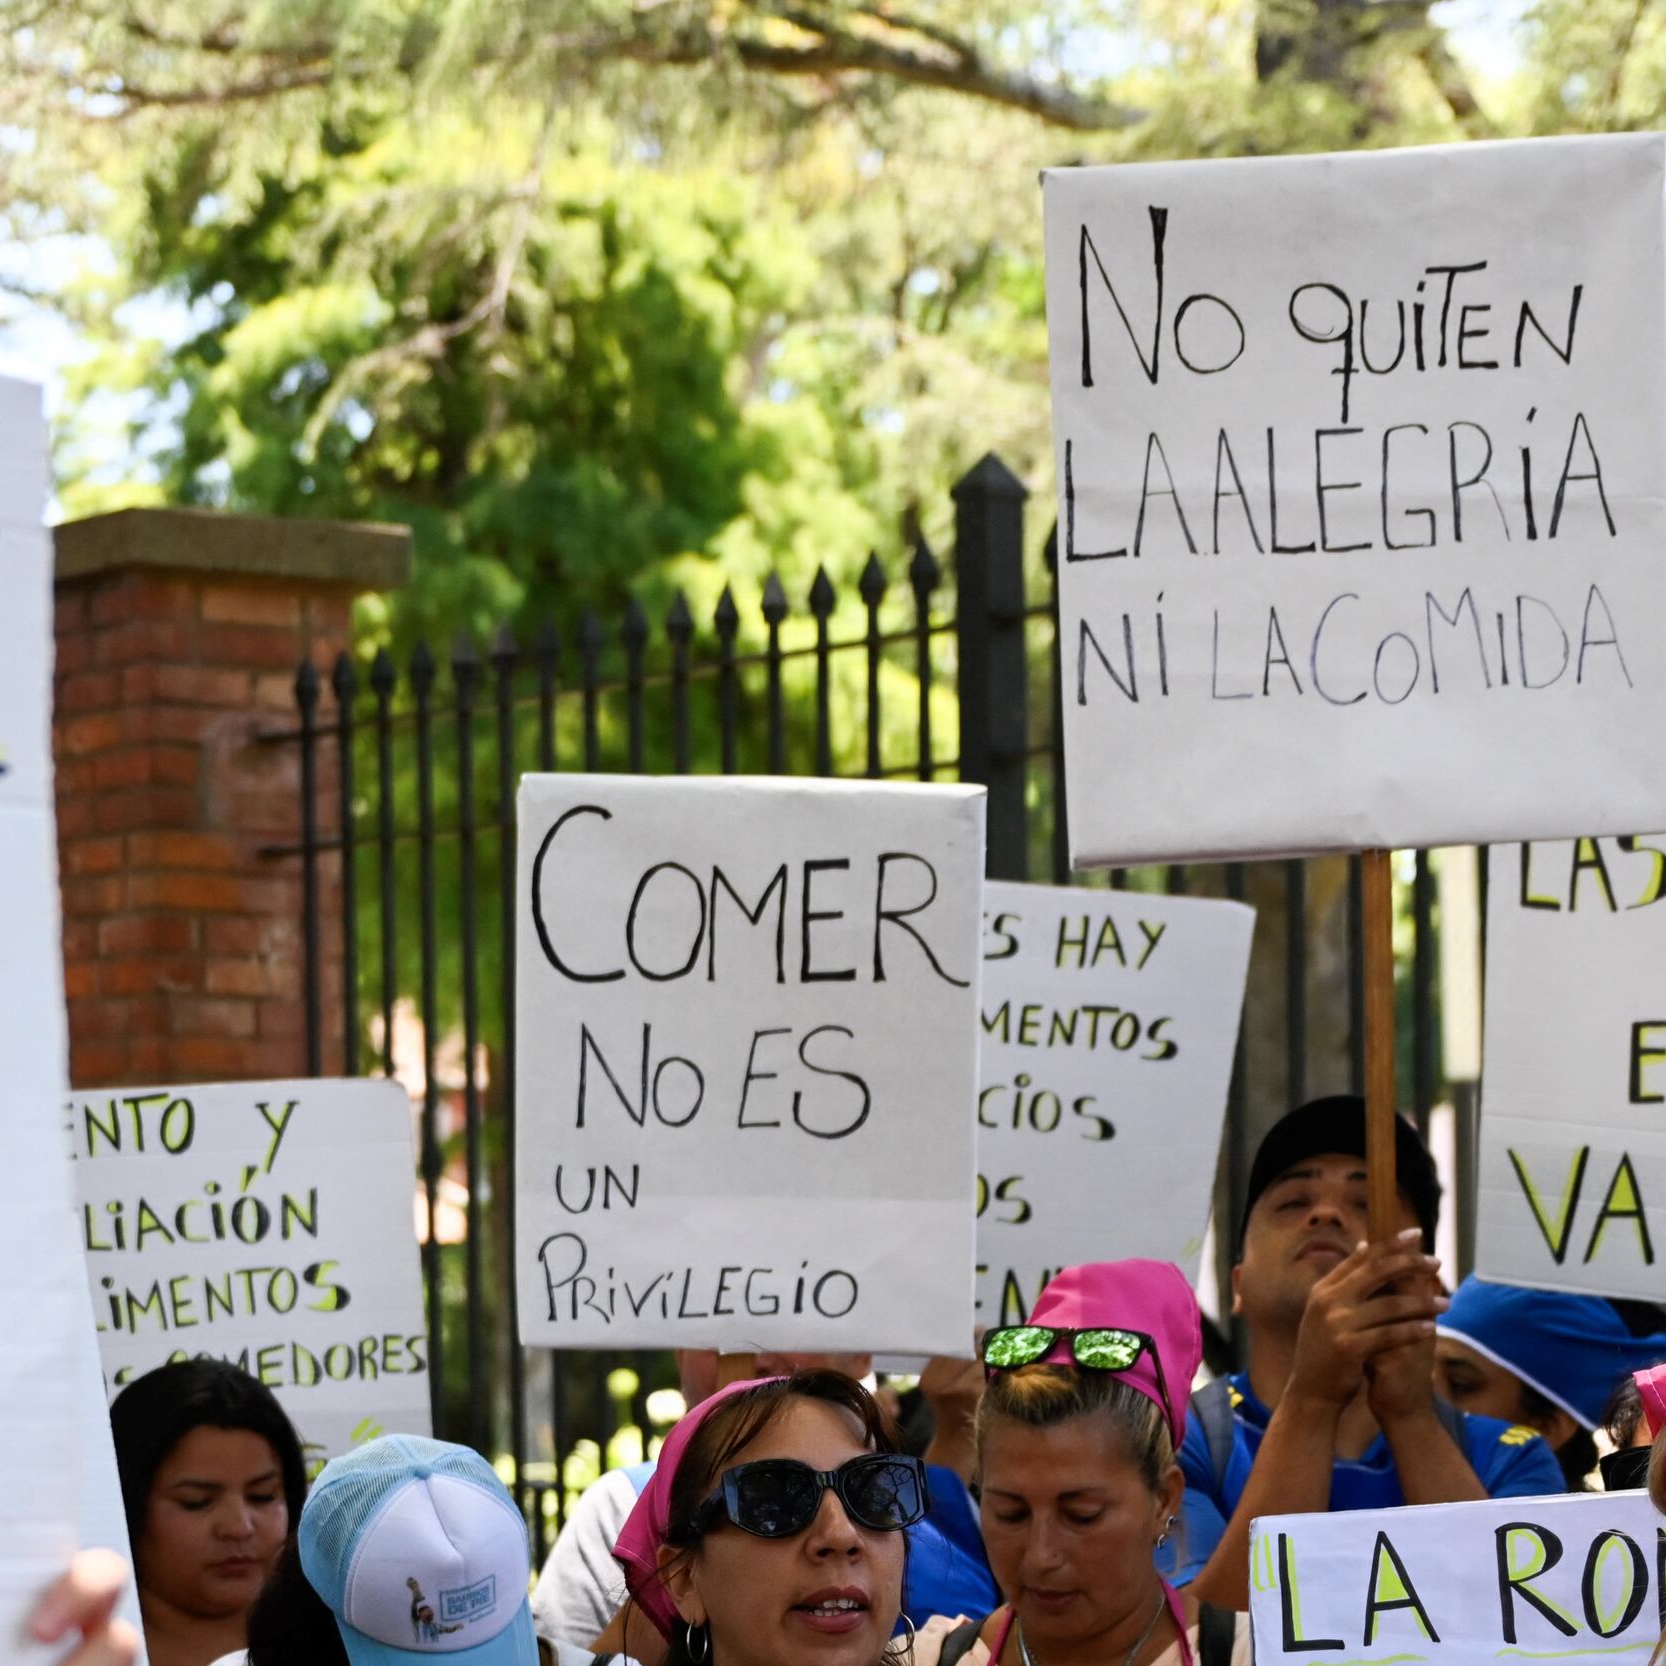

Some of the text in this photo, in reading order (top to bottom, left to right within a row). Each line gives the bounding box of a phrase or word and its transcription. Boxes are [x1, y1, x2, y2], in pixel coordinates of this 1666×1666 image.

[533, 805, 970, 988] COMER
[1055, 914, 1167, 971] HAY
[738, 1025, 872, 1139] ES
[64, 1093, 194, 1160] NTO
[556, 1163, 640, 1214] UN
